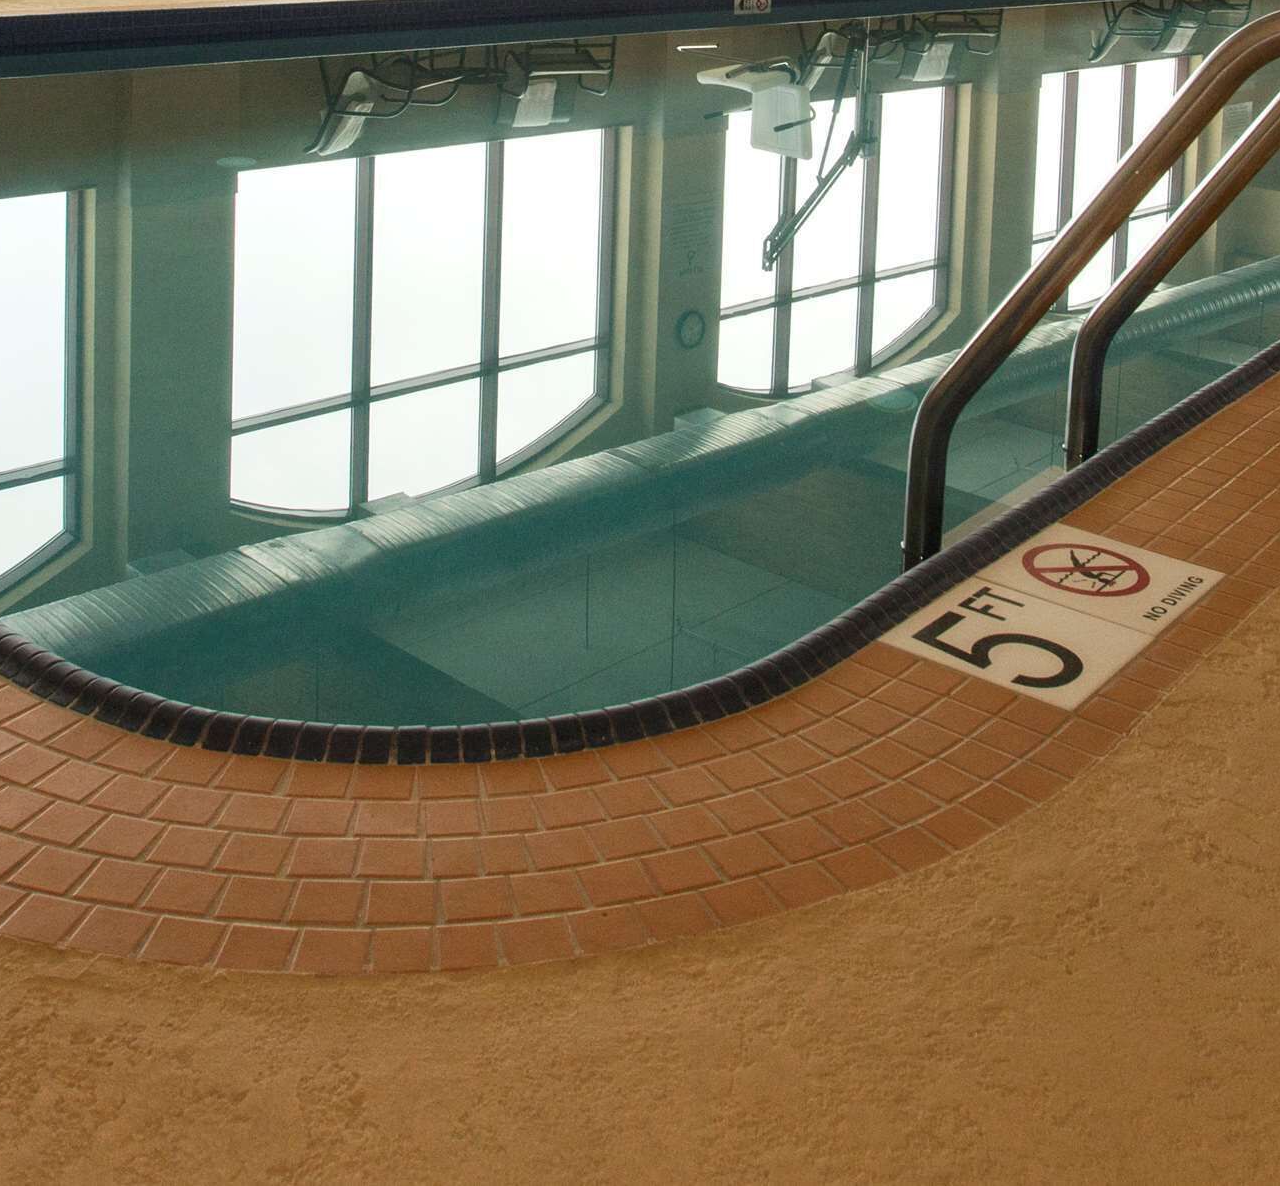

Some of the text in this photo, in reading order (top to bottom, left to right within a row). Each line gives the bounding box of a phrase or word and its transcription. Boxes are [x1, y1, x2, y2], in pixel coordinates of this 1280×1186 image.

[1142, 576, 1203, 621] NO DIVING
[912, 586, 1084, 689] 5 FT
